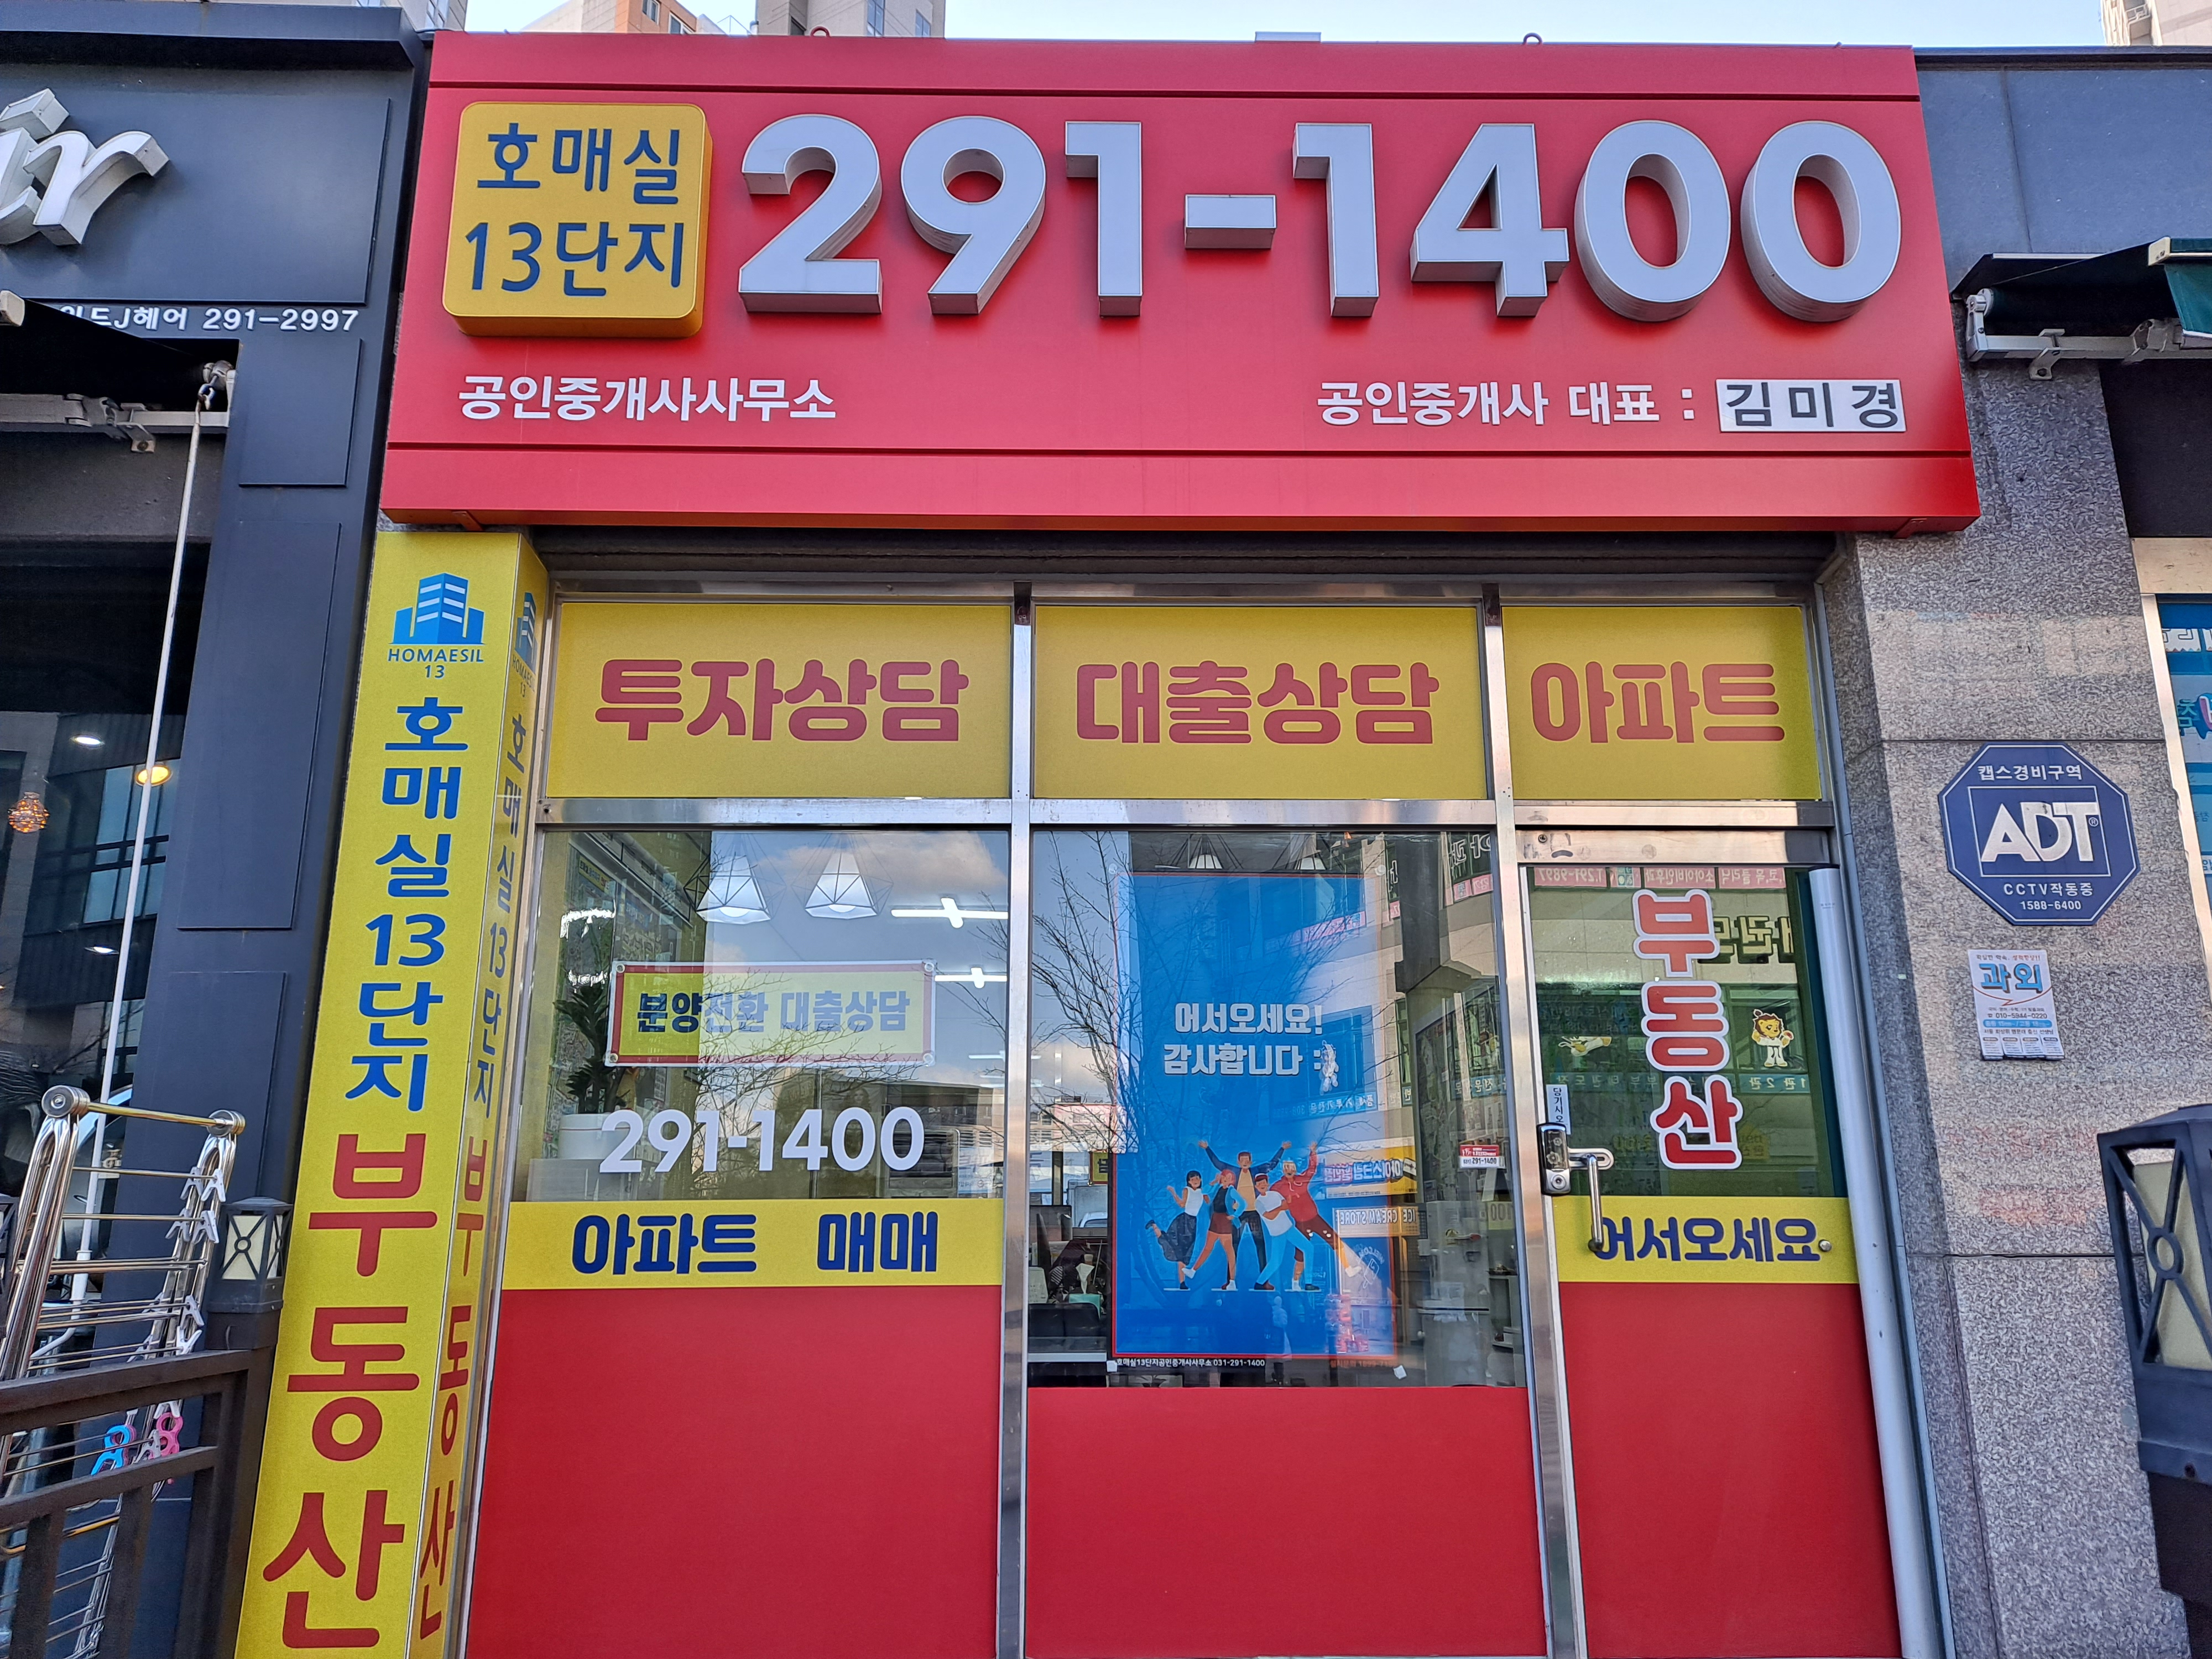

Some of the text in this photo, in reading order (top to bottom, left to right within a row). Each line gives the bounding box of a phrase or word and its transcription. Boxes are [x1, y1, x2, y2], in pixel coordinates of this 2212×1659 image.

[477, 122, 681, 205] 호매실
[738, 114, 1901, 322] 291-1400
[465, 221, 685, 297] 13단지
[202, 308, 358, 331] 291-2997
[458, 375, 837, 422] 공인중개사사무소
[1317, 380, 1549, 426] 공인중개사
[1568, 381, 1660, 425] 대표
[1726, 382, 1898, 429] 김미경
[387, 648, 484, 663] HOMAESIL
[424, 664, 445, 679] 13
[594, 657, 970, 742] 투자상담
[1076, 660, 1440, 744] 대출상담
[1530, 661, 1786, 744] 아파트
[1977, 764, 2083, 781] 캡스경비구역
[1980, 801, 2100, 862] ADT
[2003, 883, 2094, 896] CCTV작동중
[2020, 900, 2081, 911] 1588-6400
[1979, 963, 2043, 994] 과외
[780, 990, 910, 1032] 대출상담
[1174, 1001, 1323, 1036] 어서오세요!
[1634, 889, 1743, 1168] 부동산
[1164, 1042, 1303, 1076] 감사합니다
[1552, 1087, 1564, 1123] 당기시오
[599, 1106, 926, 1173] 291-1400
[571, 1211, 939, 1275] 아파트 매매
[1597, 1215, 1820, 1262] 어서오세요
[262, 1133, 438, 1648] 부동산
